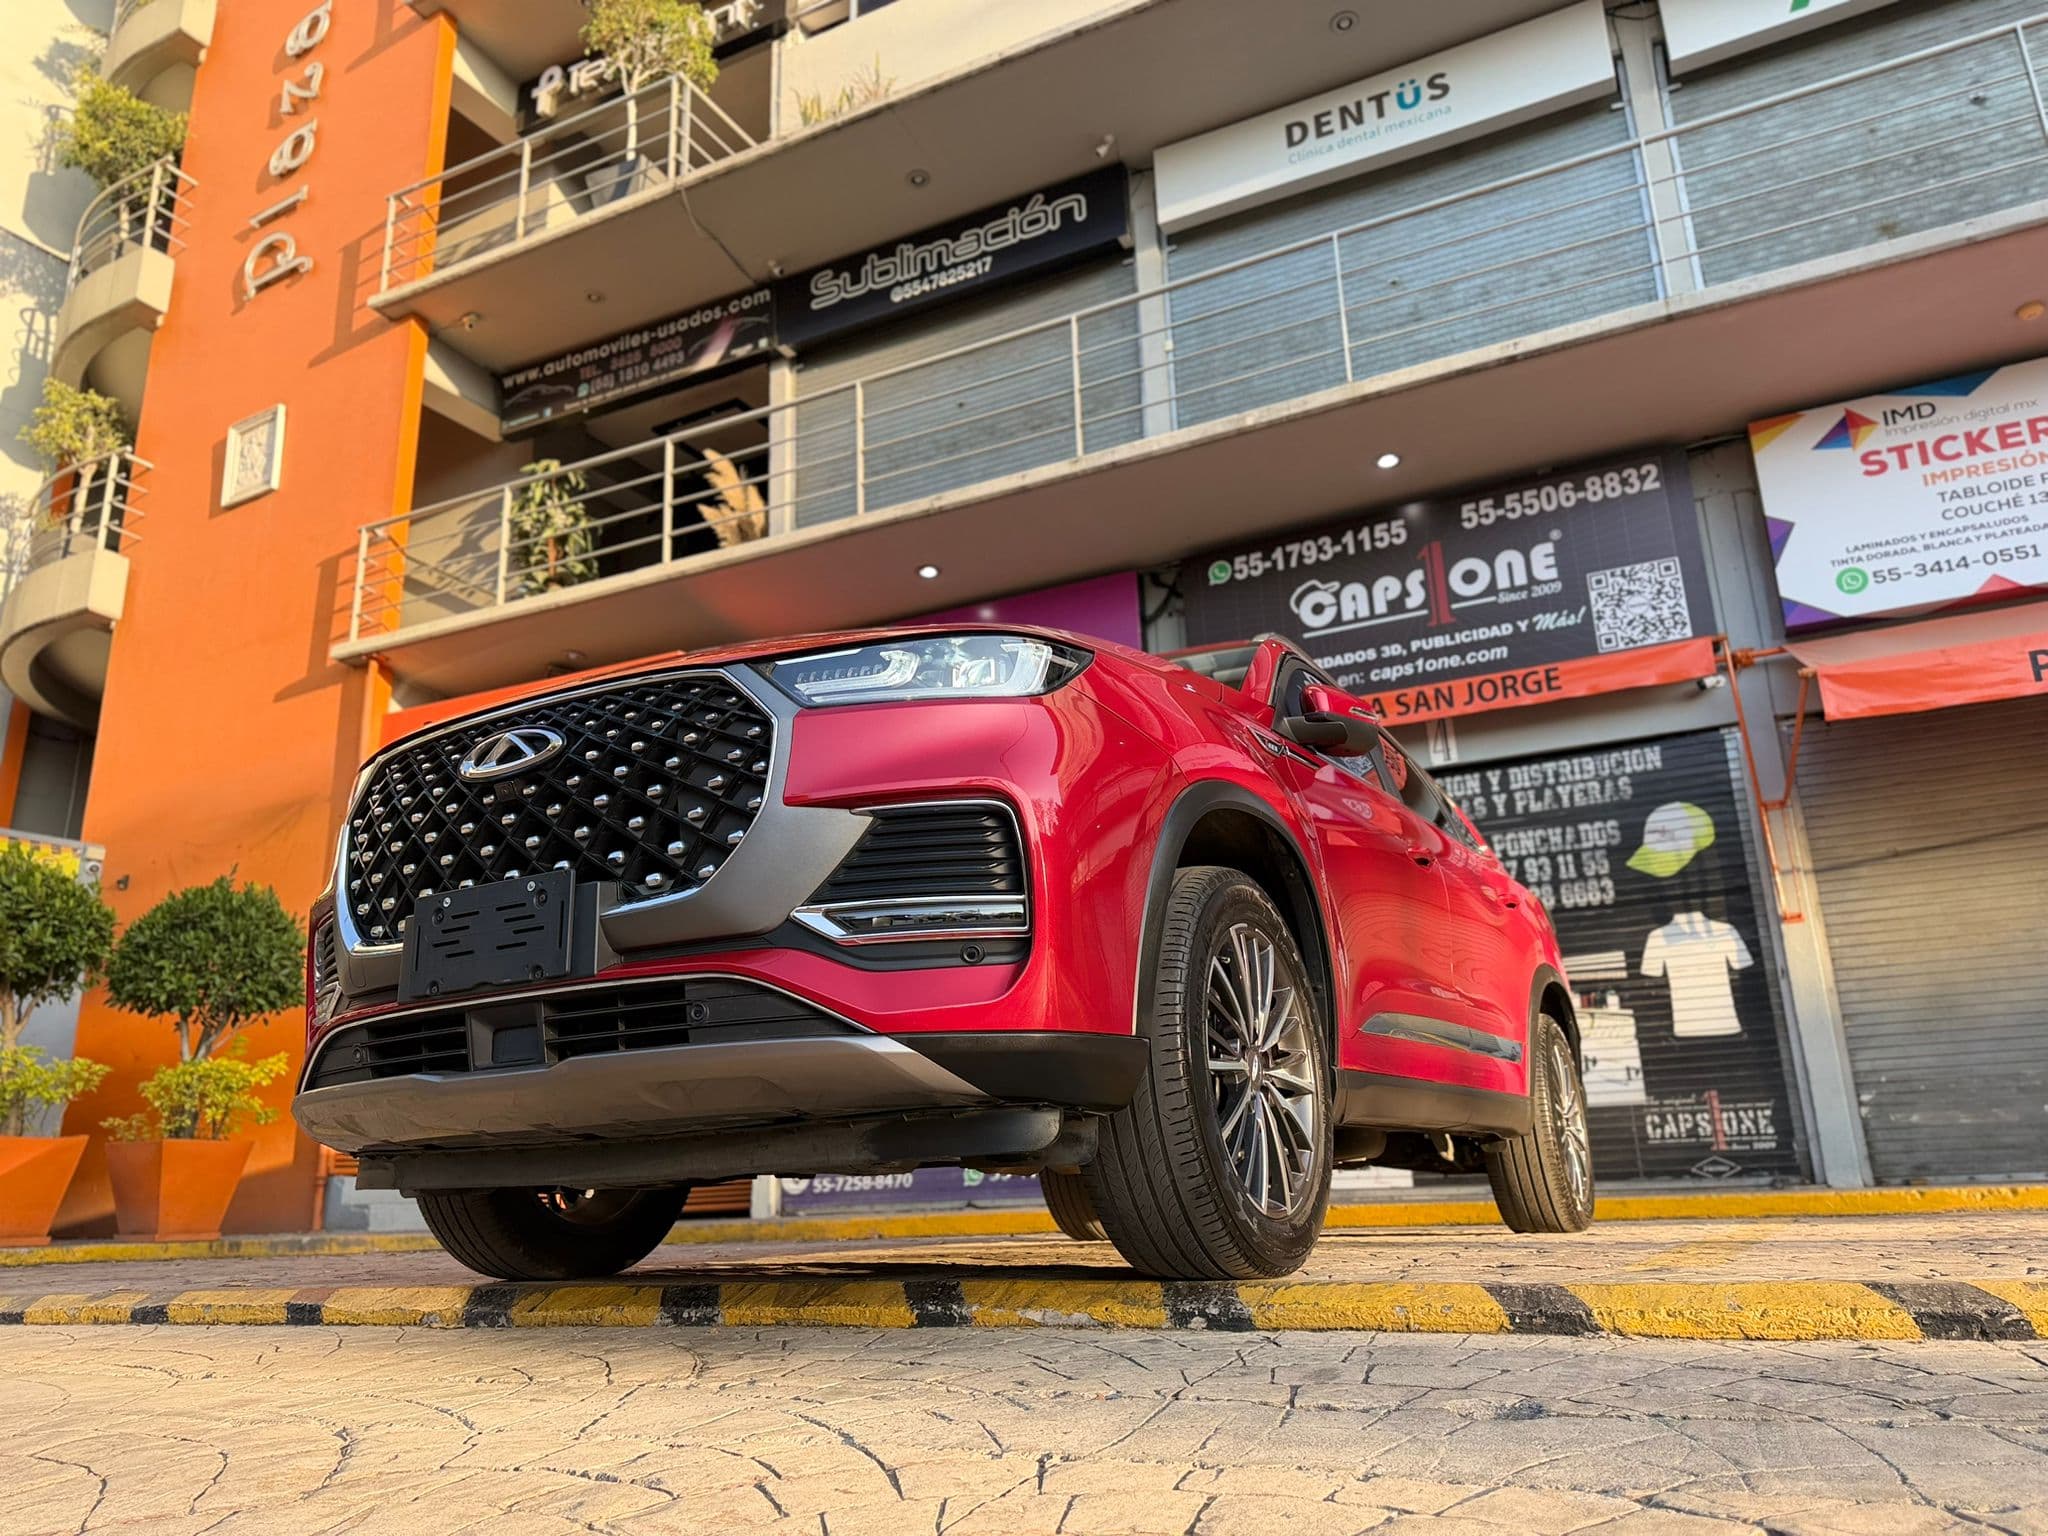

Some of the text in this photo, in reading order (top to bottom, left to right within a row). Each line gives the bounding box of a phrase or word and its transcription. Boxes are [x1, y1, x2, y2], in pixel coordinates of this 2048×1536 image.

[1285, 72, 1450, 149] DENTÜS
[1288, 105, 1452, 165] Clínica dental mexicana
[810, 193, 1087, 310] Sublimación
[502, 288, 771, 389] www.automoviles-usados.com
[1882, 401, 1937, 427] IMD
[1964, 403, 2011, 422] digital
[2014, 399, 2040, 412] mx
[1460, 463, 1661, 529] 55-5506-8832
[1937, 474, 2037, 503] TABLOIDE
[1941, 494, 2026, 521] COUCHÉ
[1232, 519, 1408, 581] 55-1793-1155
[1831, 553, 1865, 568] TINTA
[1923, 537, 1974, 552] BLANCA
[1975, 534, 1984, 542] Y
[1845, 535, 1918, 554] LAMINADOS
[1920, 532, 1928, 541] Y
[1872, 543, 2042, 585] 55-3414-0551
[1497, 580, 1562, 605] Since 2009
[1381, 641, 1406, 659] 3D,
[1410, 624, 1513, 653] PUBLICIDAD
[1517, 619, 1530, 633] Y
[1531, 605, 1588, 632] Más!
[1337, 645, 1509, 688] en: caps1one.com
[1396, 685, 1456, 717] SAN
[1463, 667, 1563, 706] JORGE
[1486, 769, 1502, 793] Y
[1508, 745, 1664, 790] DISTRIBUCION
[1492, 793, 1509, 817] Y
[1514, 776, 1634, 815] PLAYERAS
[1524, 856, 1553, 883] 93
[1556, 853, 1578, 880] 11
[1581, 848, 1611, 877] 55
